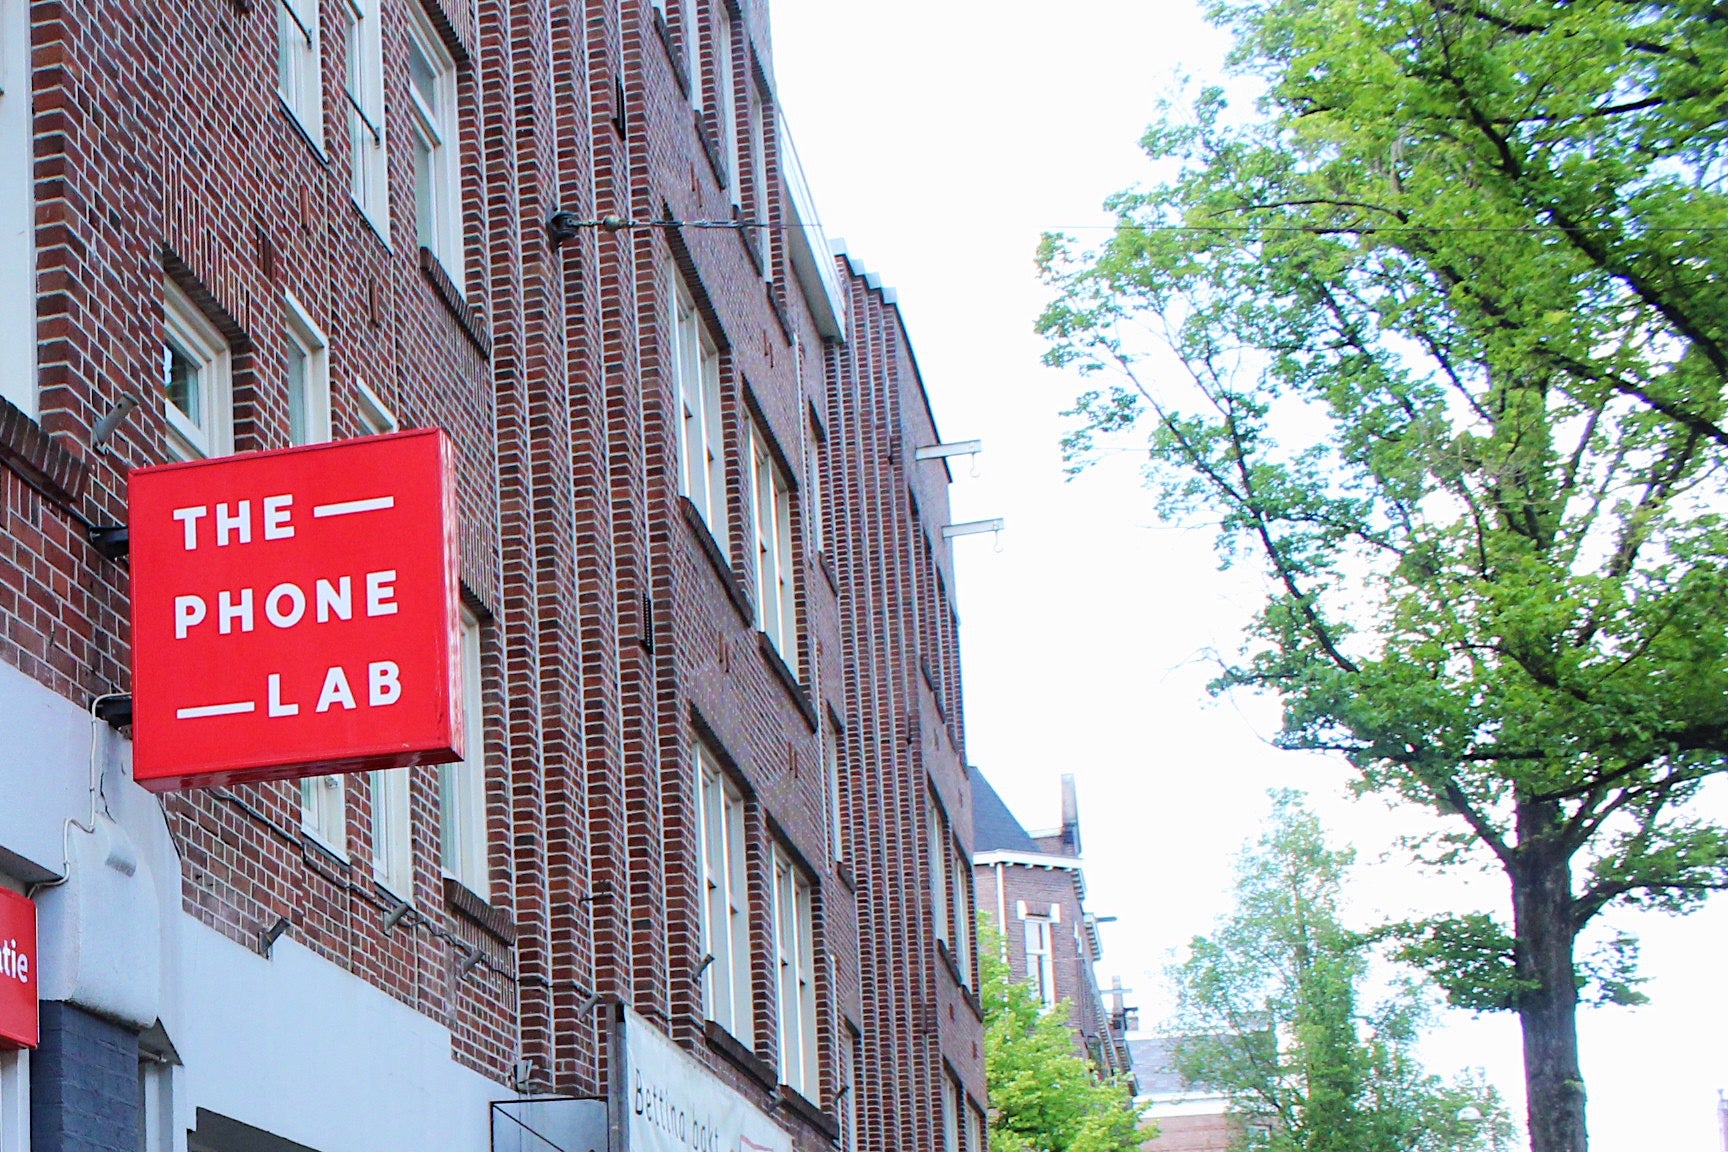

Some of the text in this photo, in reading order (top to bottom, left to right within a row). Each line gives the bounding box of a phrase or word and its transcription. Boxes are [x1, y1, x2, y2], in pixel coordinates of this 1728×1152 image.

[173, 494, 295, 550] THE
[174, 569, 399, 639] PHONE
[267, 660, 403, 718] LAB
[635, 1067, 686, 1143] Bettina
